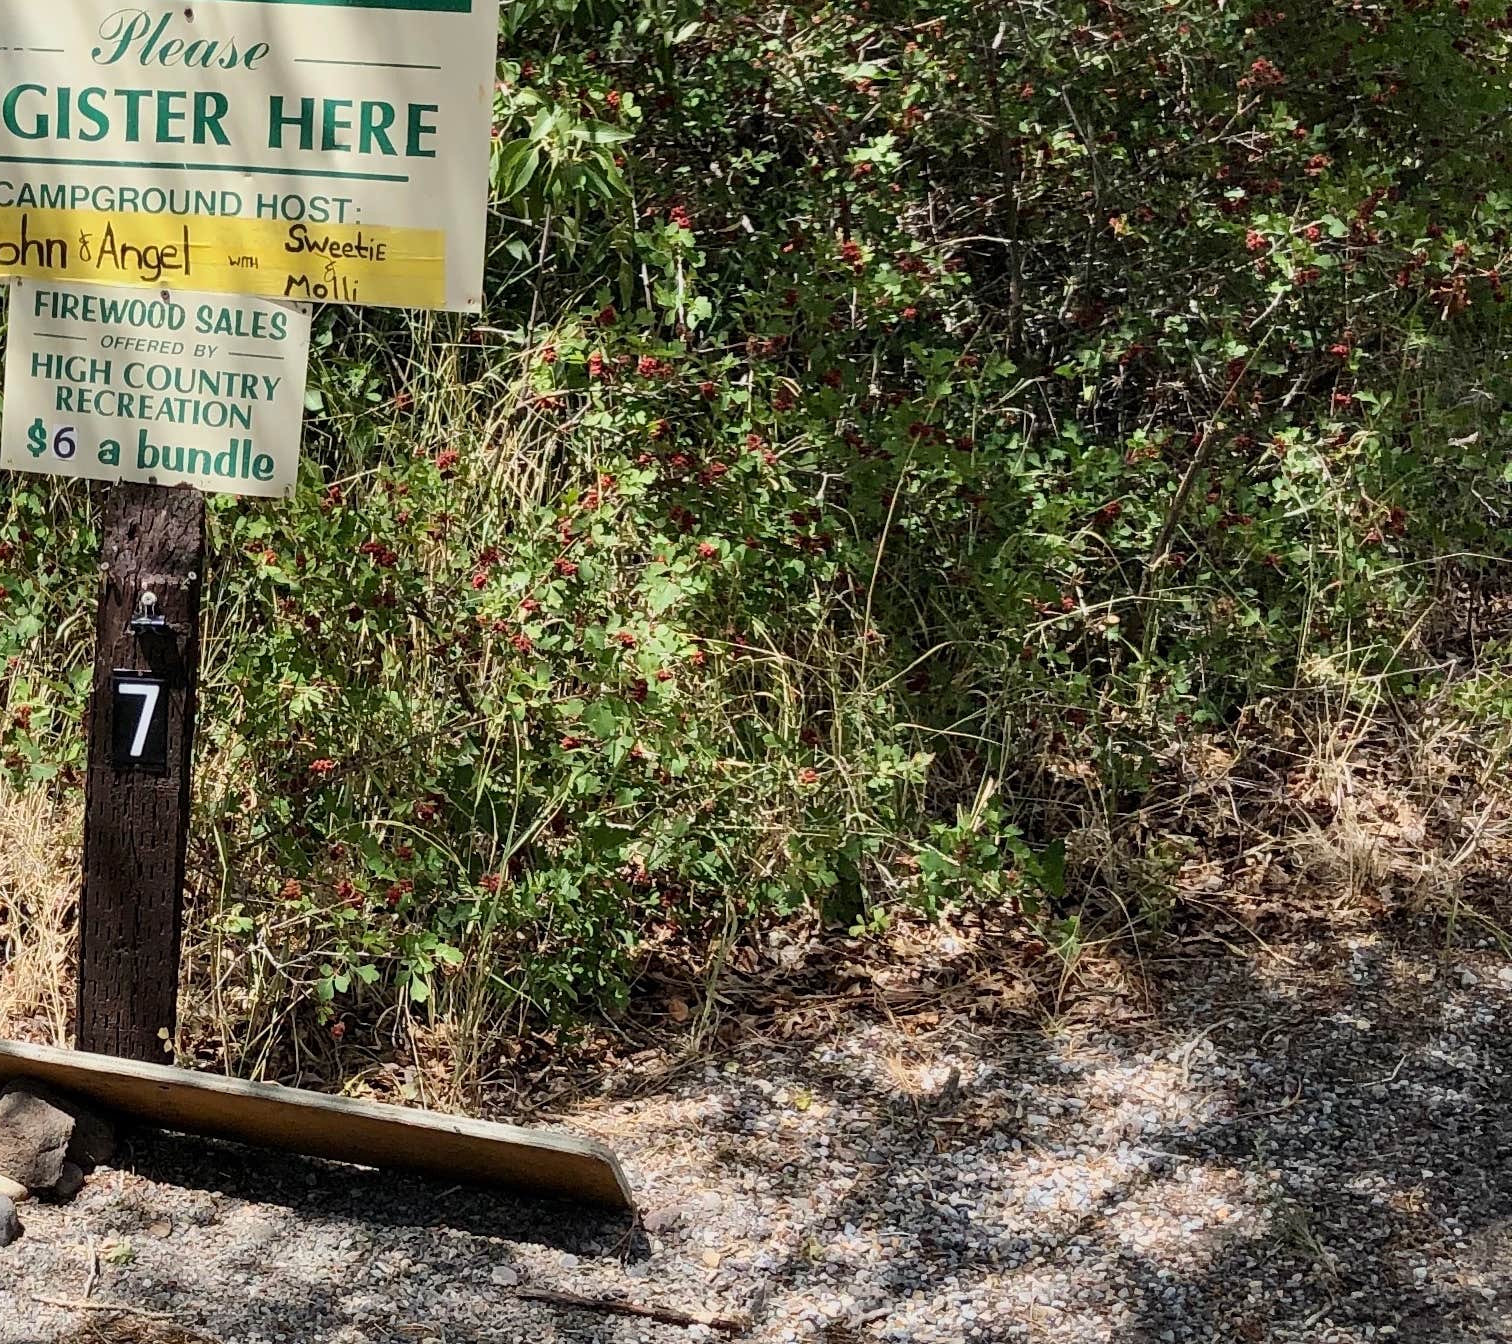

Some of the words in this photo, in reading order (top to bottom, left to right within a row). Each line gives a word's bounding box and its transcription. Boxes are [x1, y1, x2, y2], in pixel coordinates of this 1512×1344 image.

[90, 8, 271, 71] Please
[267, 95, 439, 158] HERE
[256, 191, 362, 225] HOST:
[95, 220, 191, 282] Angel
[283, 274, 359, 303] Molli
[34, 290, 186, 331] FIREWOOD
[195, 304, 288, 341] SALES
[100, 334, 184, 355] OFFERED
[193, 343, 218, 359] BY
[30, 352, 112, 385] HIGH
[123, 361, 282, 401] COUNTRY
[55, 385, 253, 430] RECREATION
[97, 438, 121, 467] a
[136, 428, 275, 482] bundle
[117, 682, 161, 758] 7
